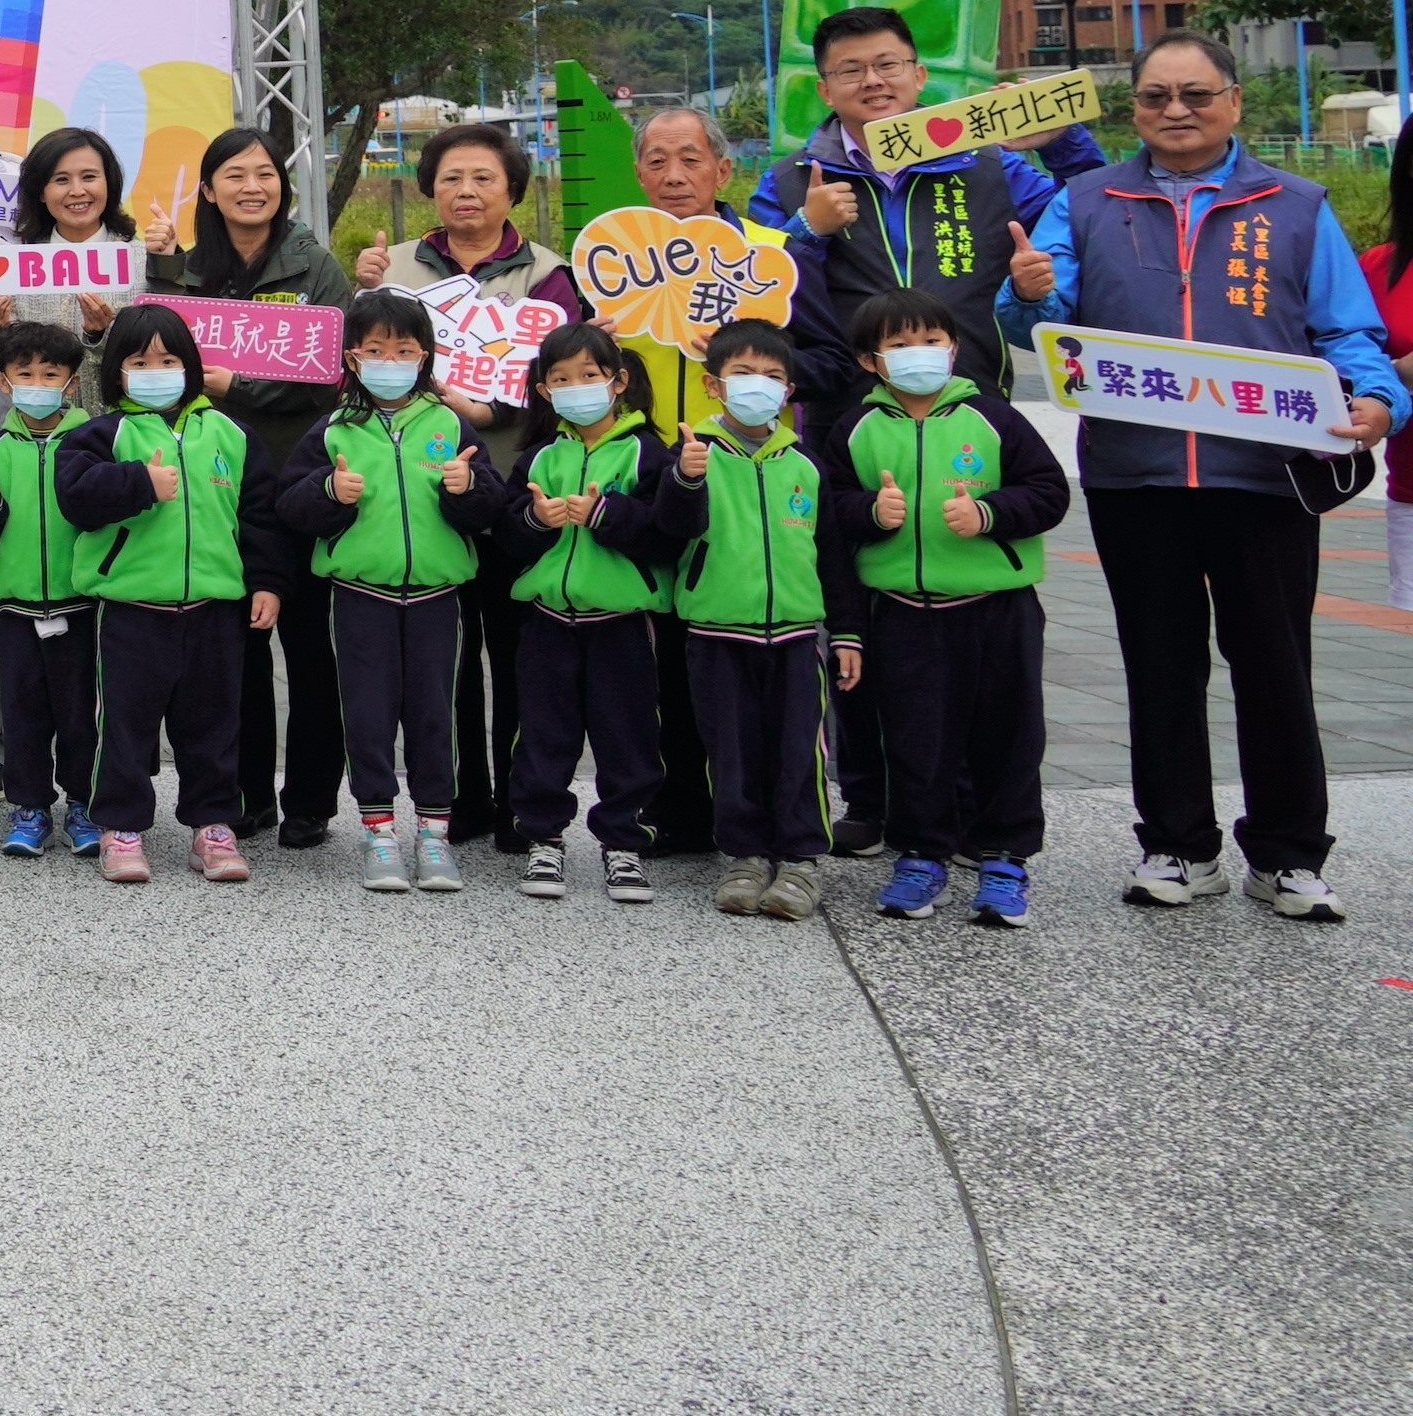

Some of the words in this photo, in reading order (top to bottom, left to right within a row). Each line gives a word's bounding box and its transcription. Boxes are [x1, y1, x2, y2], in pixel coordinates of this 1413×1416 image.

[590, 110, 612, 122] 1.8M
[878, 123, 922, 161] 我
[966, 80, 1086, 139] 新北市
[18, 248, 130, 288] BALI
[587, 238, 699, 298] Cue
[457, 304, 559, 347] 八里
[687, 282, 738, 327] 我
[1097, 359, 1319, 424] 緊來八里勝
